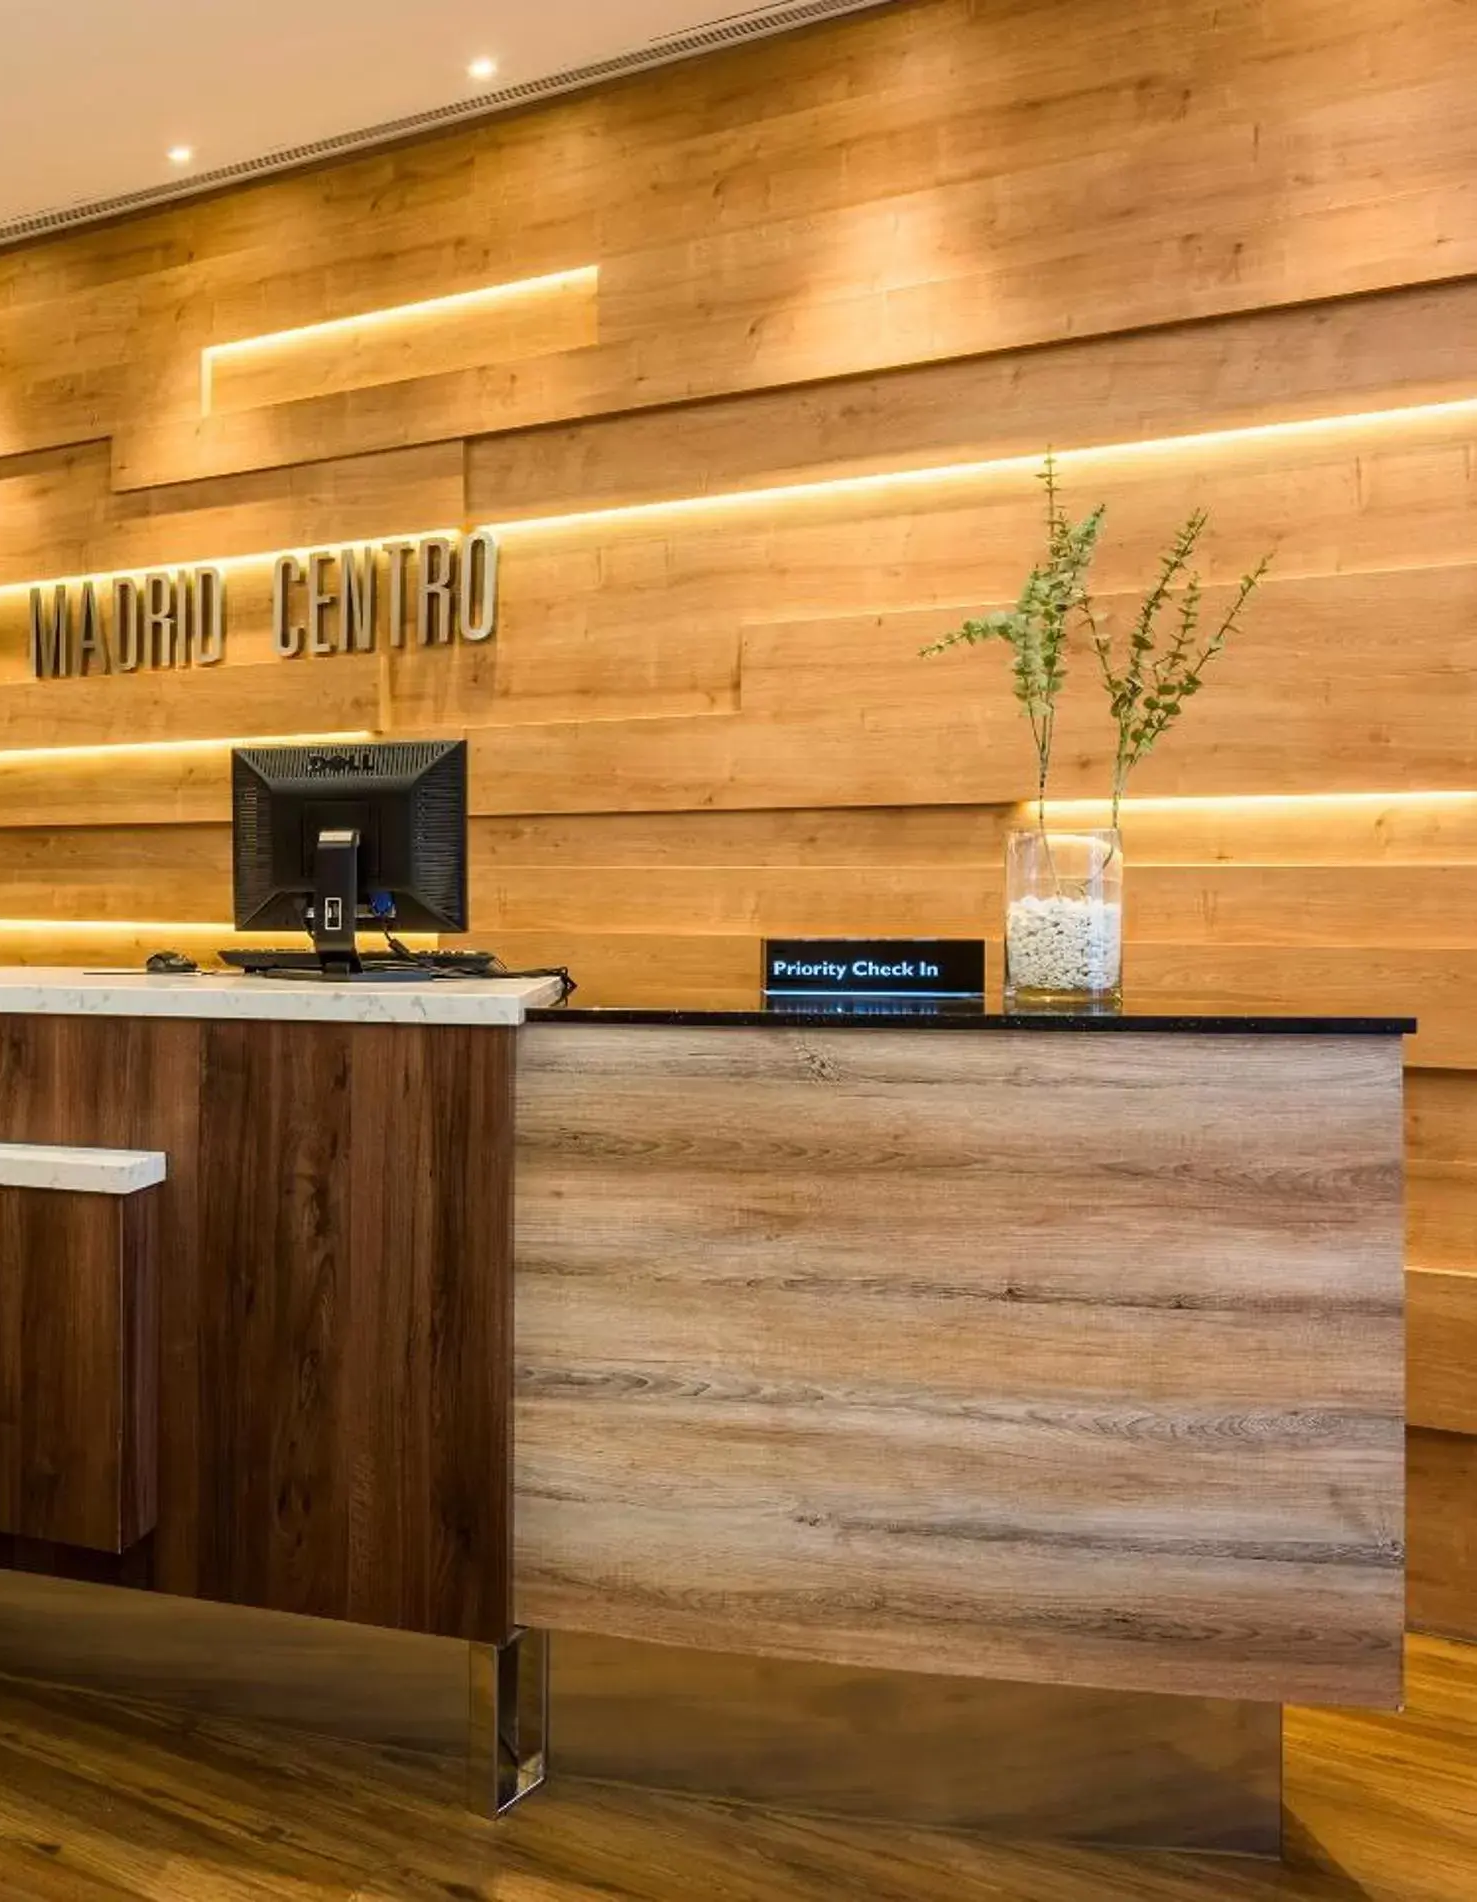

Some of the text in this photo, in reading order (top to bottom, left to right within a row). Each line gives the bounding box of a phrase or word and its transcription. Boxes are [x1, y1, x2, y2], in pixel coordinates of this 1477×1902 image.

[29, 531, 499, 679] MADRID CENTRO
[773, 960, 939, 980] Priority Check In
